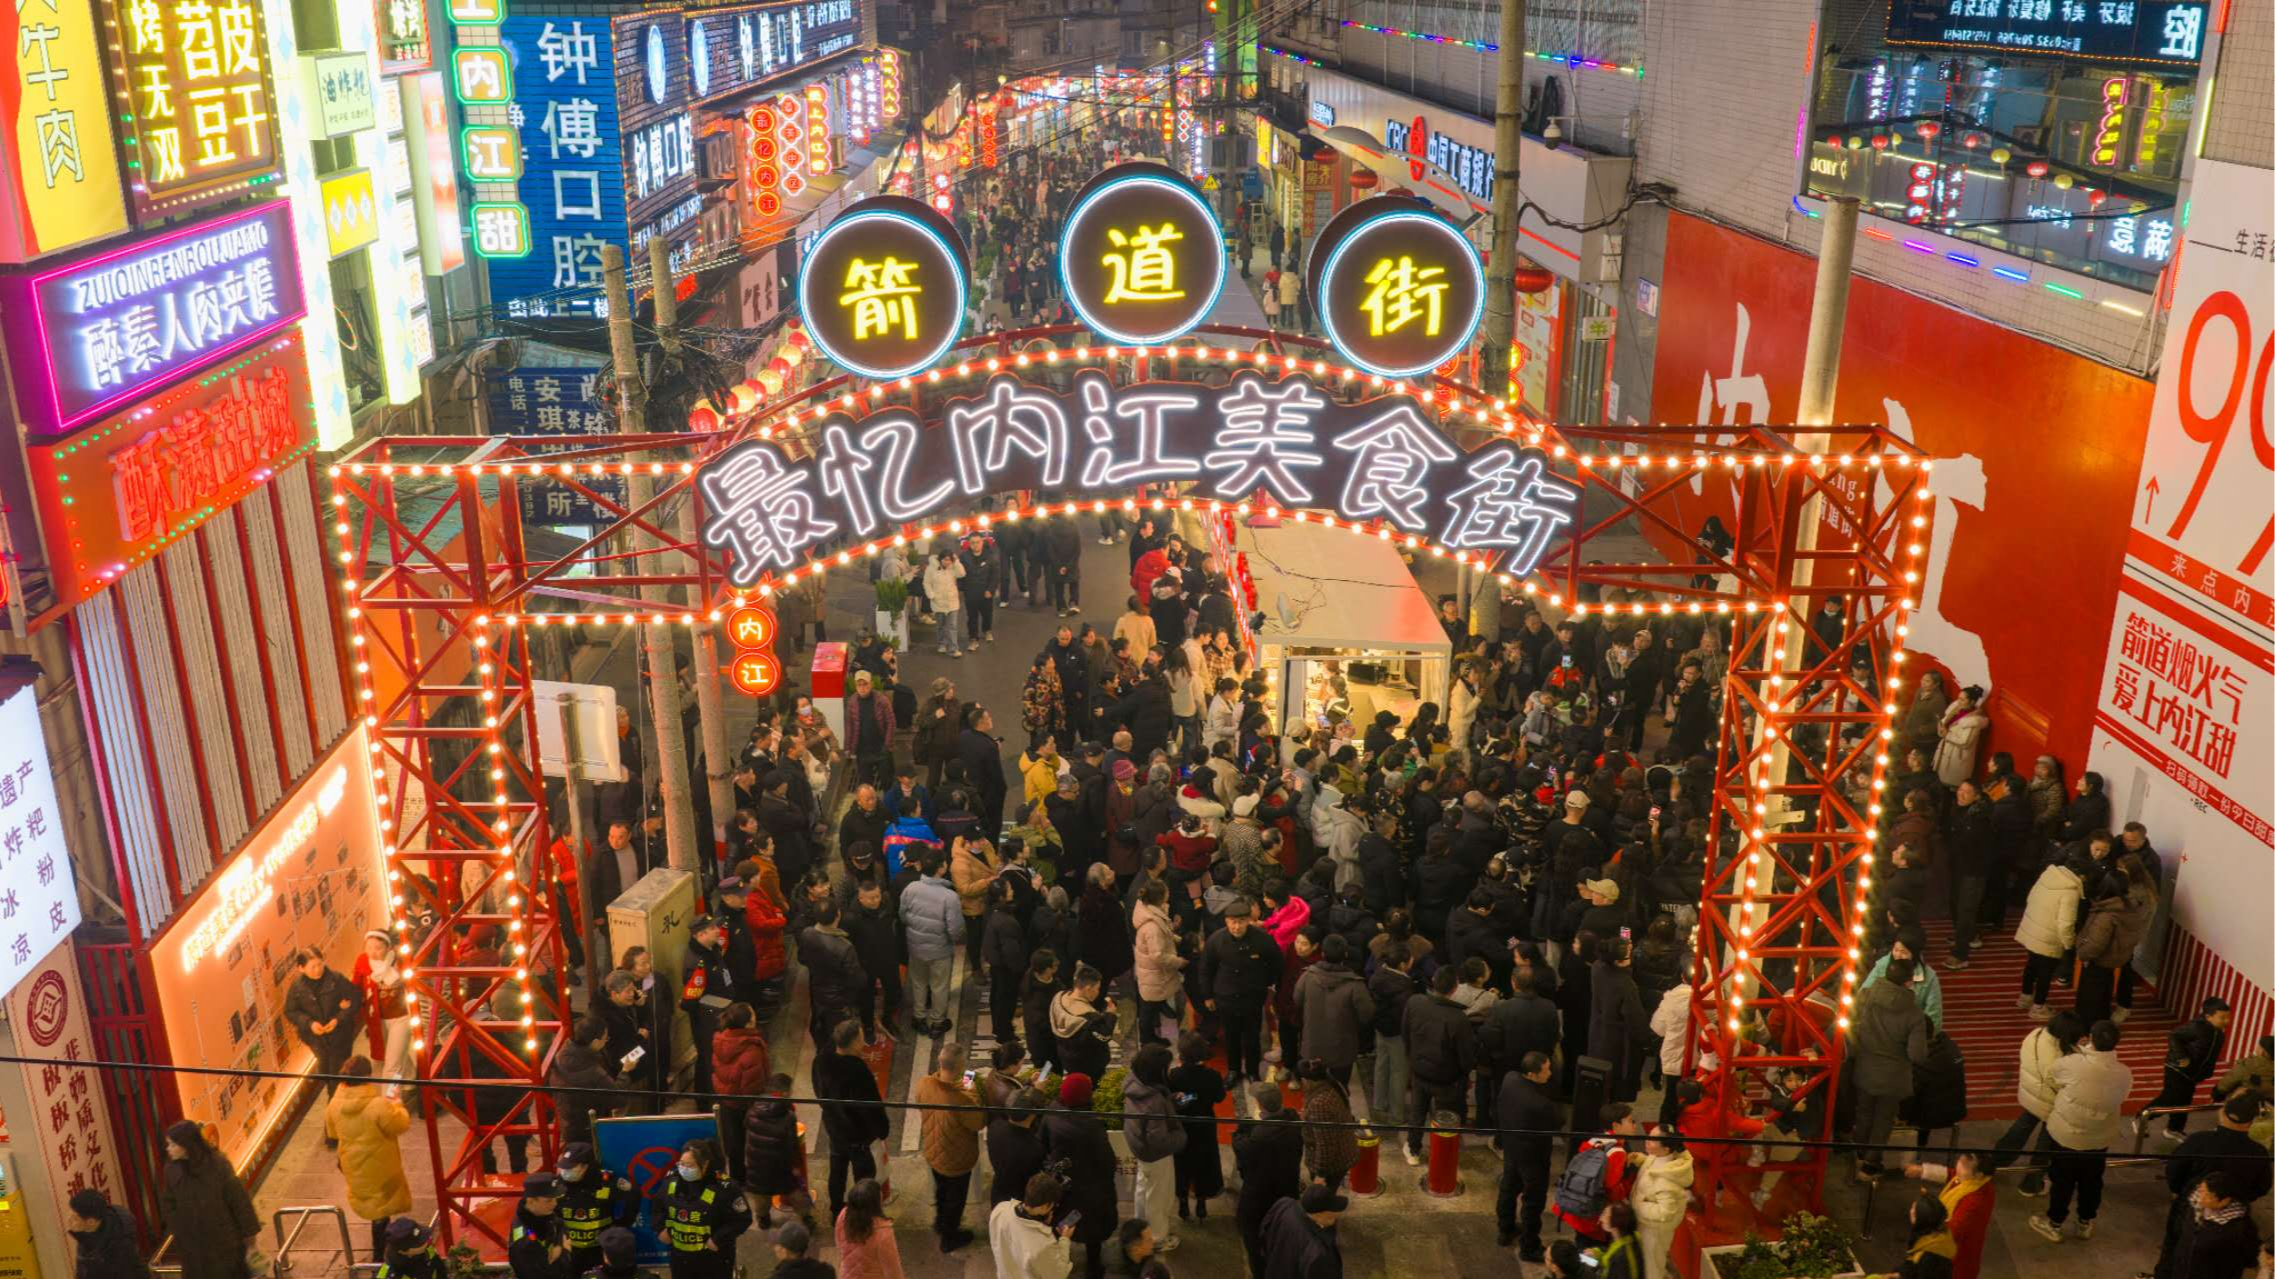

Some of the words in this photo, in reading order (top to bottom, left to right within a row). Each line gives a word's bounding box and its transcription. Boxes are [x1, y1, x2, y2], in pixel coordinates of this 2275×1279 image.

[176, 0, 262, 82] 苕皮
[188, 83, 267, 167] 豆干
[537, 20, 607, 290] 钟傅口腔
[2234, 228, 2275, 263] 生活
[702, 379, 1578, 584] 最忆内江美食街
[738, 617, 769, 684] 内江
[2119, 611, 2248, 725] 箭道烟火气
[2111, 663, 2237, 780] 爱上内江甜
